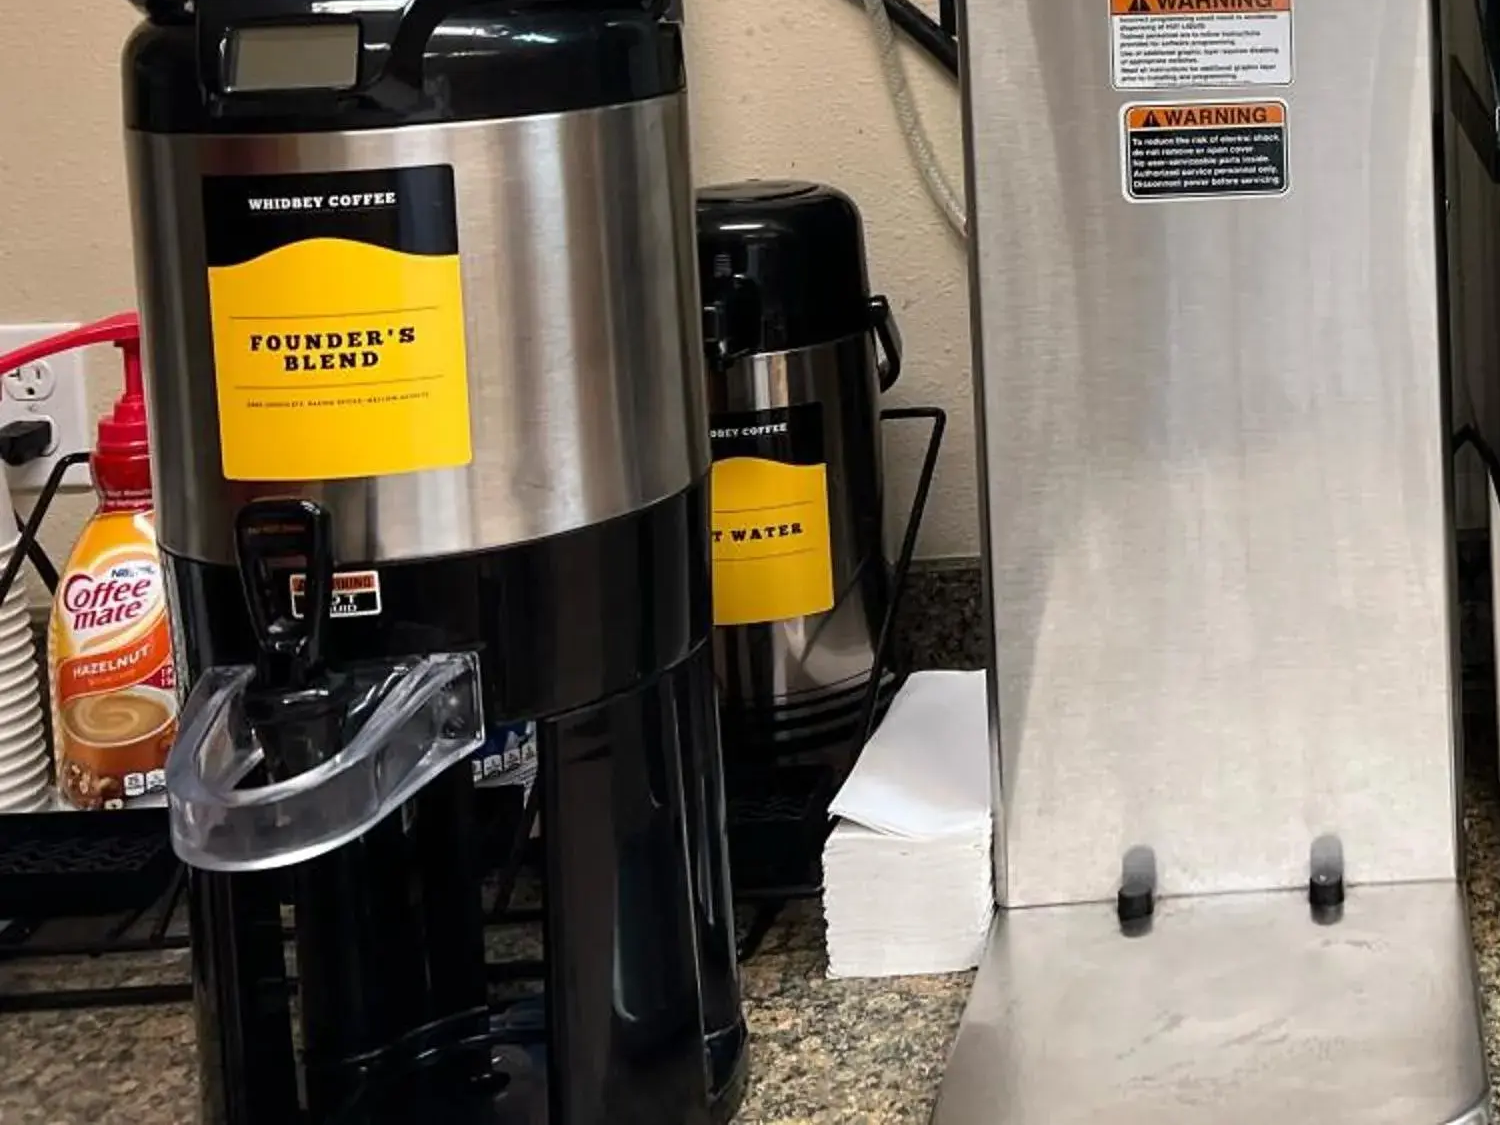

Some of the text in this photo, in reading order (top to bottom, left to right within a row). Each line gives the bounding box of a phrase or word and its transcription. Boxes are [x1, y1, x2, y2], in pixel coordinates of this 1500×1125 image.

[1165, 106, 1267, 125] WARNING
[248, 192, 396, 210] WHIDBEY COFFEE
[249, 327, 416, 352] FOUNDER'S
[284, 350, 380, 372] BLEND
[741, 422, 787, 437] COFFEE
[731, 523, 803, 542] WATER
[64, 573, 151, 613] Coffee
[74, 601, 142, 631] mate
[73, 646, 150, 677] HAZELNUT
